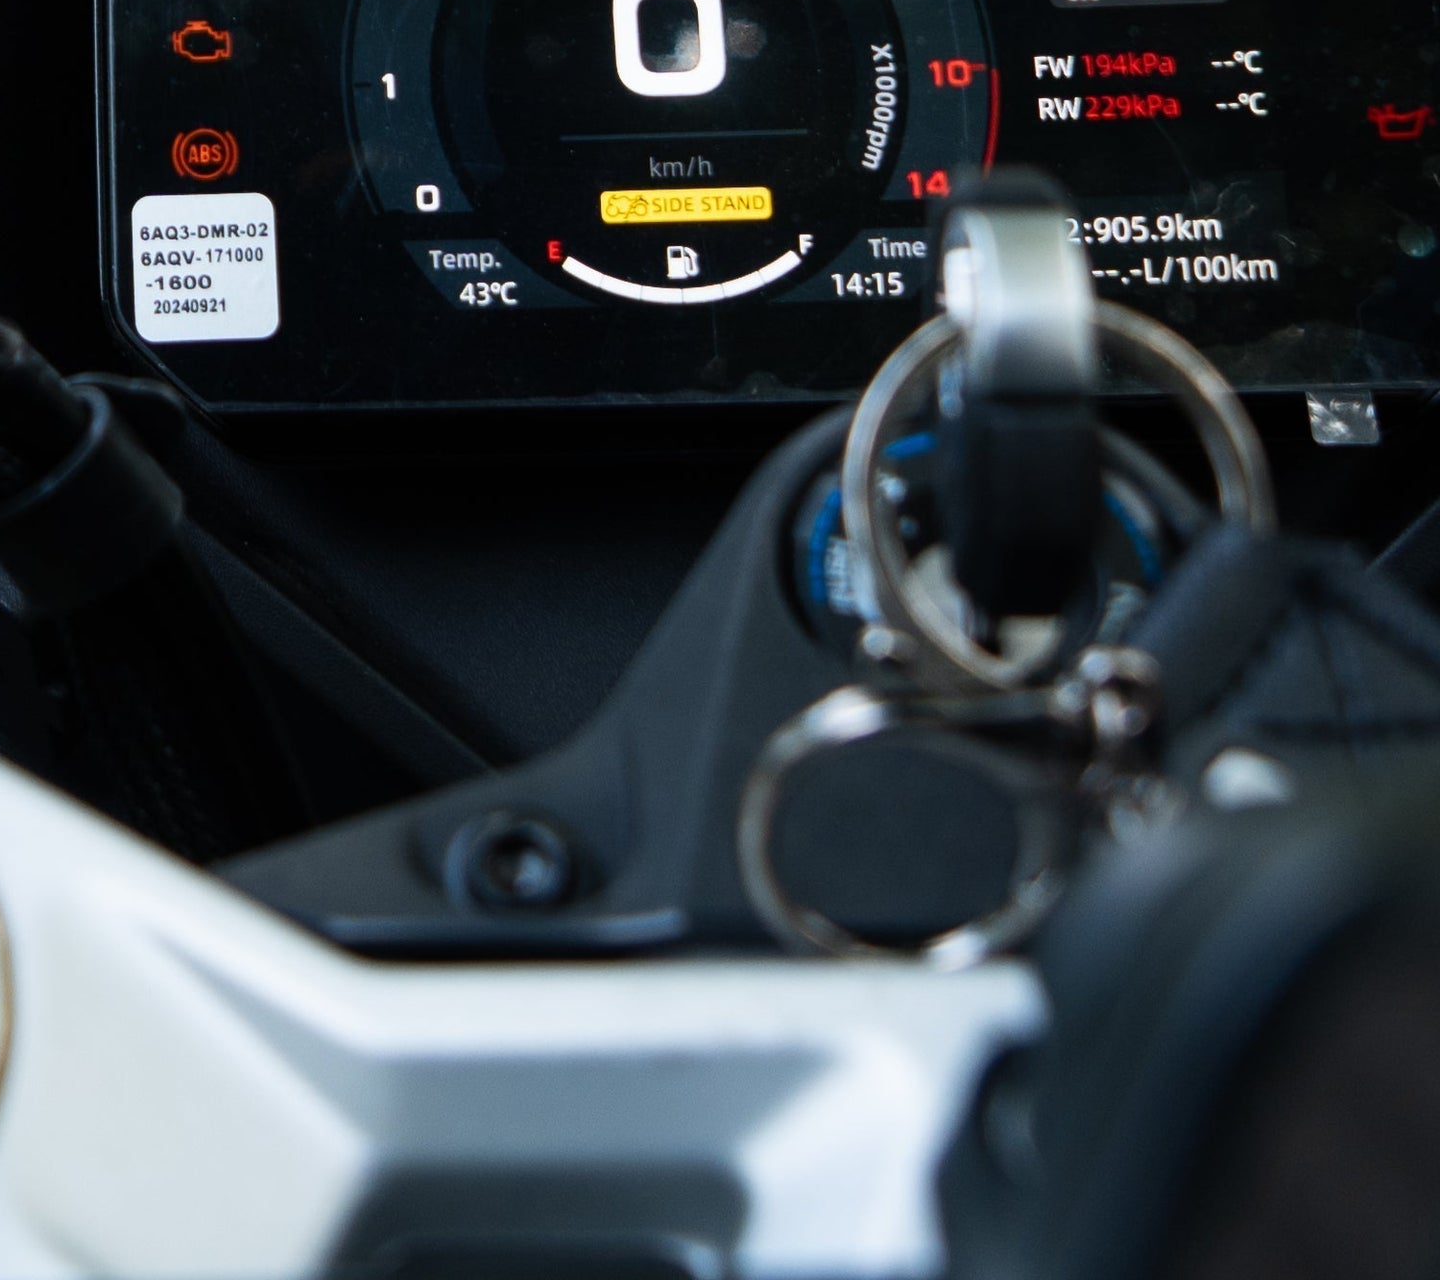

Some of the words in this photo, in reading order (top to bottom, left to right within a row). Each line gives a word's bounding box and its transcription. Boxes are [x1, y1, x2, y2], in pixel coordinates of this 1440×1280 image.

[928, 59, 970, 88] 10
[1033, 54, 1074, 79] FW
[1081, 51, 1176, 77] 194kPa
[380, 72, 396, 100] 1
[1037, 96, 1081, 121] RW
[1084, 93, 1182, 120] 229kPa
[188, 144, 222, 162] ABS
[649, 155, 713, 178] km/h
[906, 169, 950, 199] 14
[416, 184, 440, 212] 0
[651, 194, 694, 214] SIDE
[700, 192, 766, 213] STAND
[140, 222, 269, 241] 6AQ3-DMR-02
[548, 240, 562, 259] E
[799, 233, 814, 256] F
[867, 237, 928, 258] Time
[428, 249, 502, 273] Temp.
[146, 274, 212, 291] -1600
[831, 271, 905, 297] 14:15
[154, 297, 226, 315] 20240921
